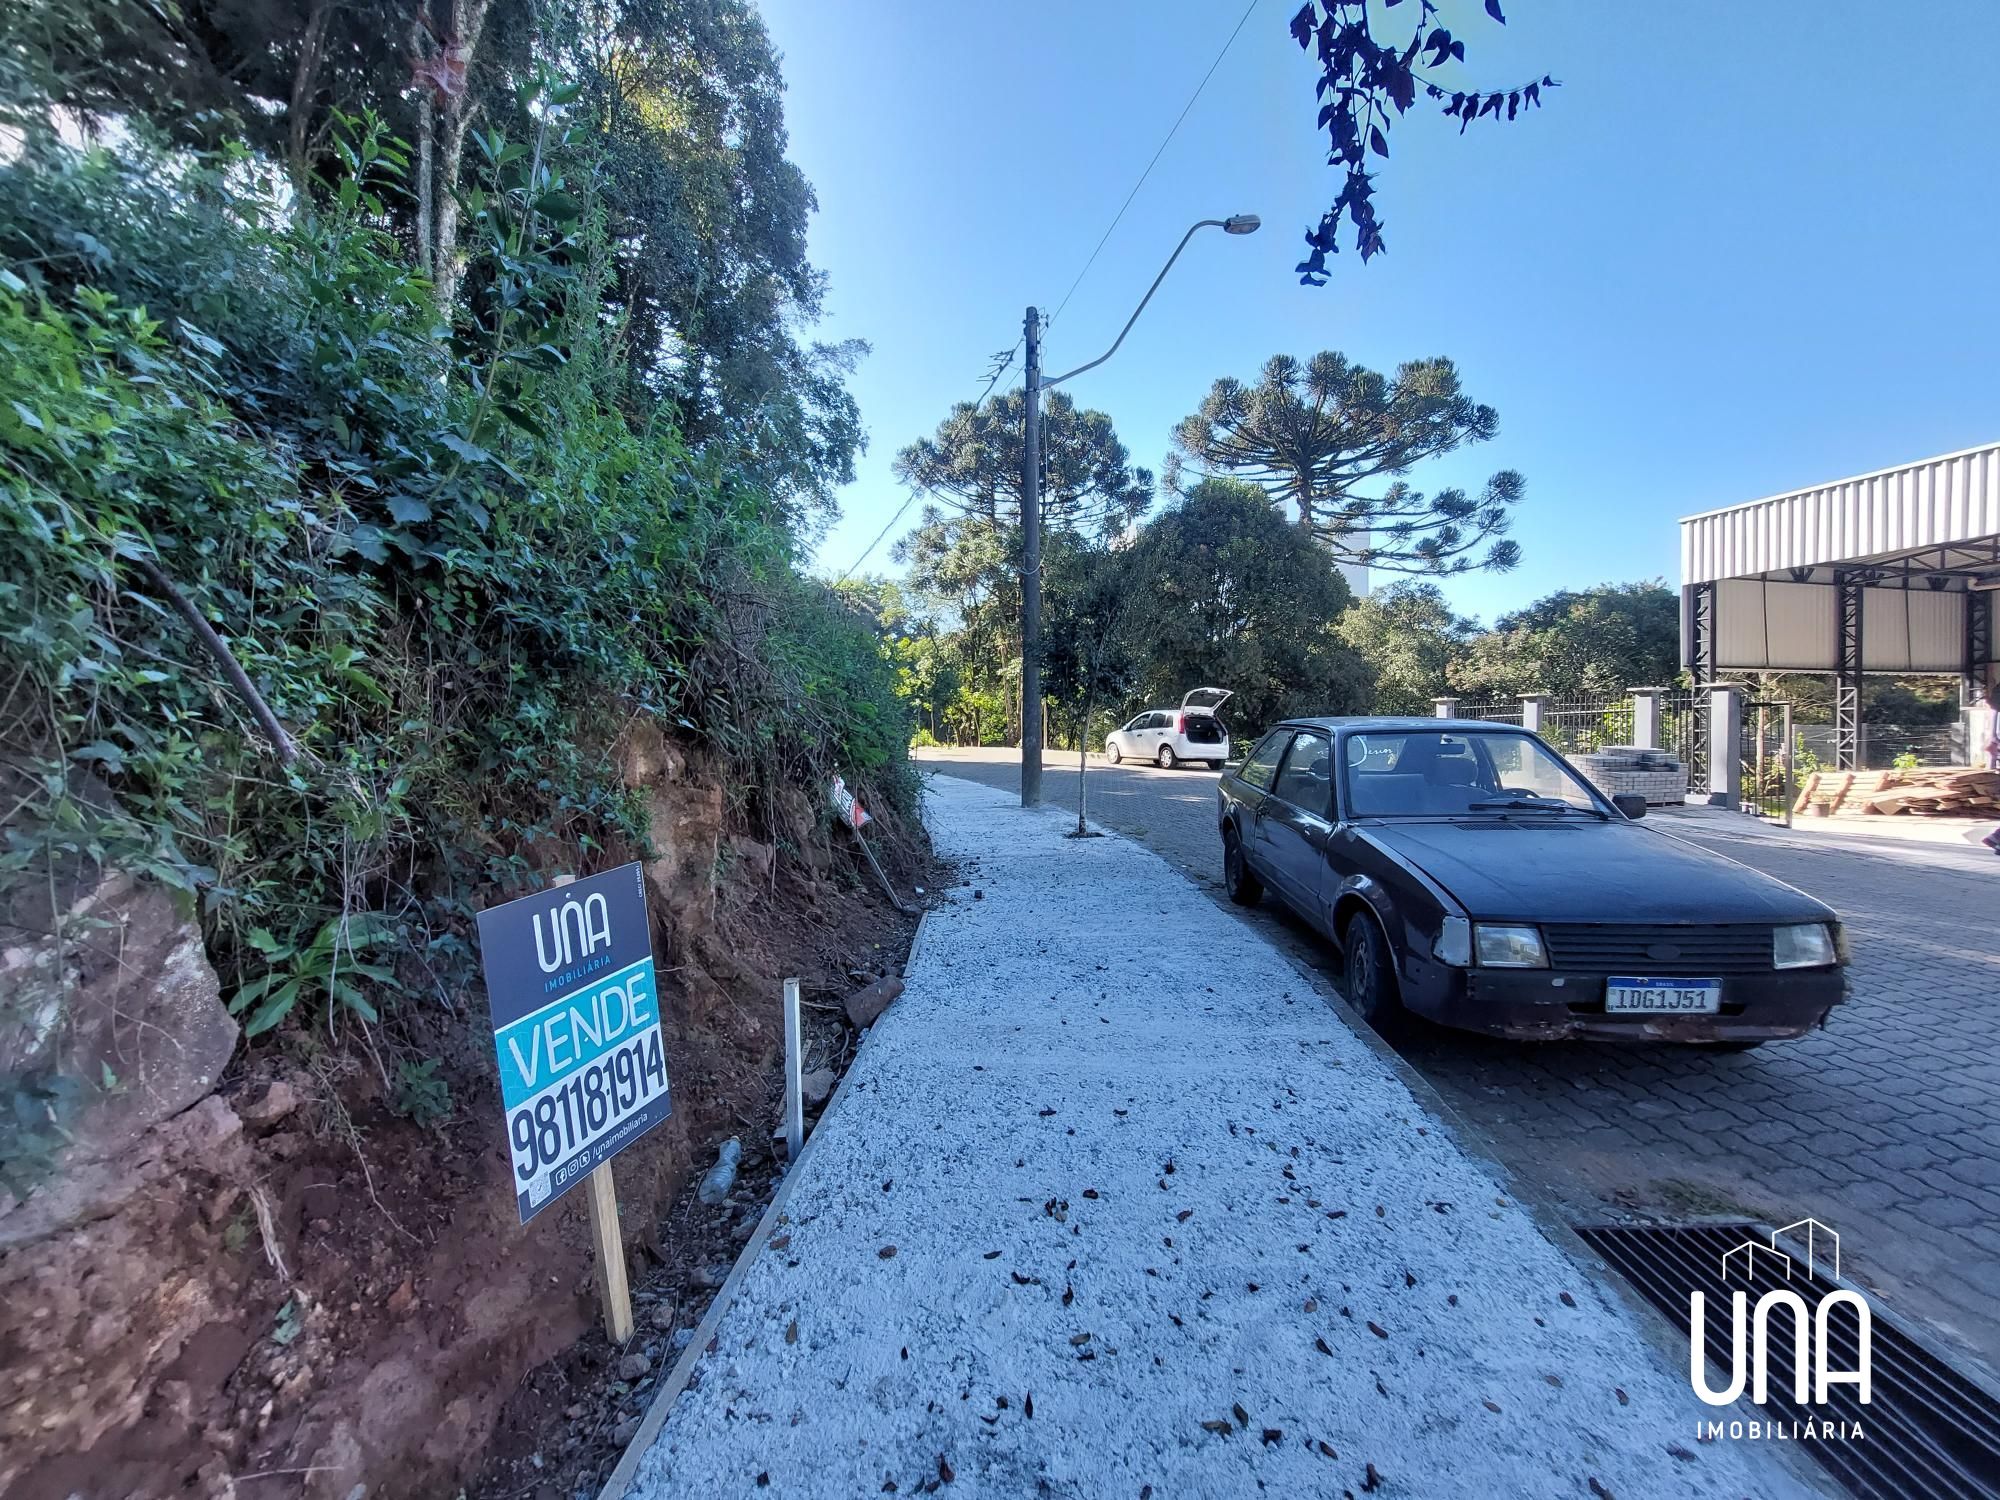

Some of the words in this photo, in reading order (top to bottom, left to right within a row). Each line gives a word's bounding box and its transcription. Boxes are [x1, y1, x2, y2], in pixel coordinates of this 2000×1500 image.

[532, 892, 612, 973] UNA
[544, 955, 612, 993] IMOBILIÁRIA
[1615, 990, 1707, 1009] IDG1J51
[508, 971, 651, 1088] VENDE
